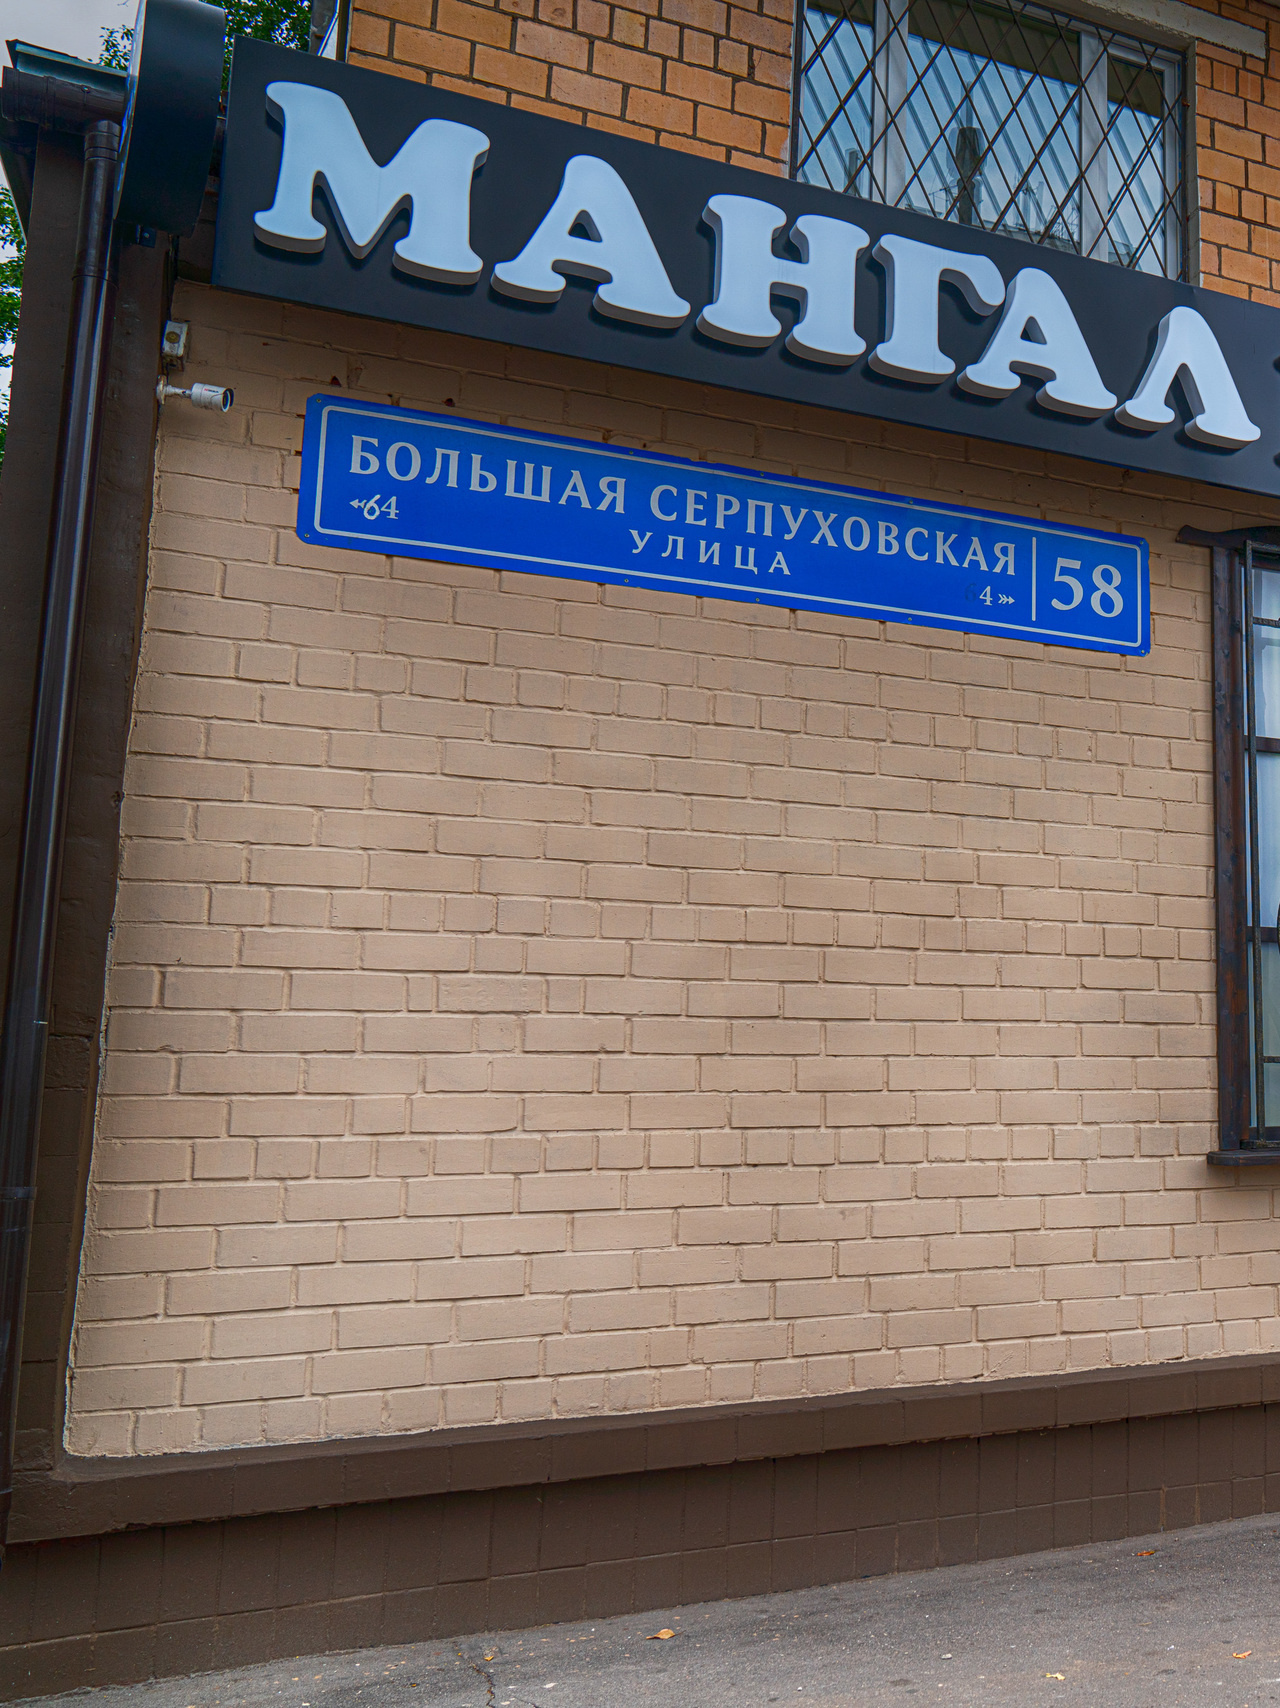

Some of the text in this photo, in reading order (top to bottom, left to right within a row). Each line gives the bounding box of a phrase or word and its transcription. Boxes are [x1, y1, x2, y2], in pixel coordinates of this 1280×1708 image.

[254, 82, 1261, 449] МАНГАЛ
[349, 434, 1016, 576] БОЛЬШАЯ СЕРПУХОВСКАЯ
[362, 494, 399, 520] 64
[628, 529, 792, 576] УЛИЦА
[1051, 557, 1124, 618] 58
